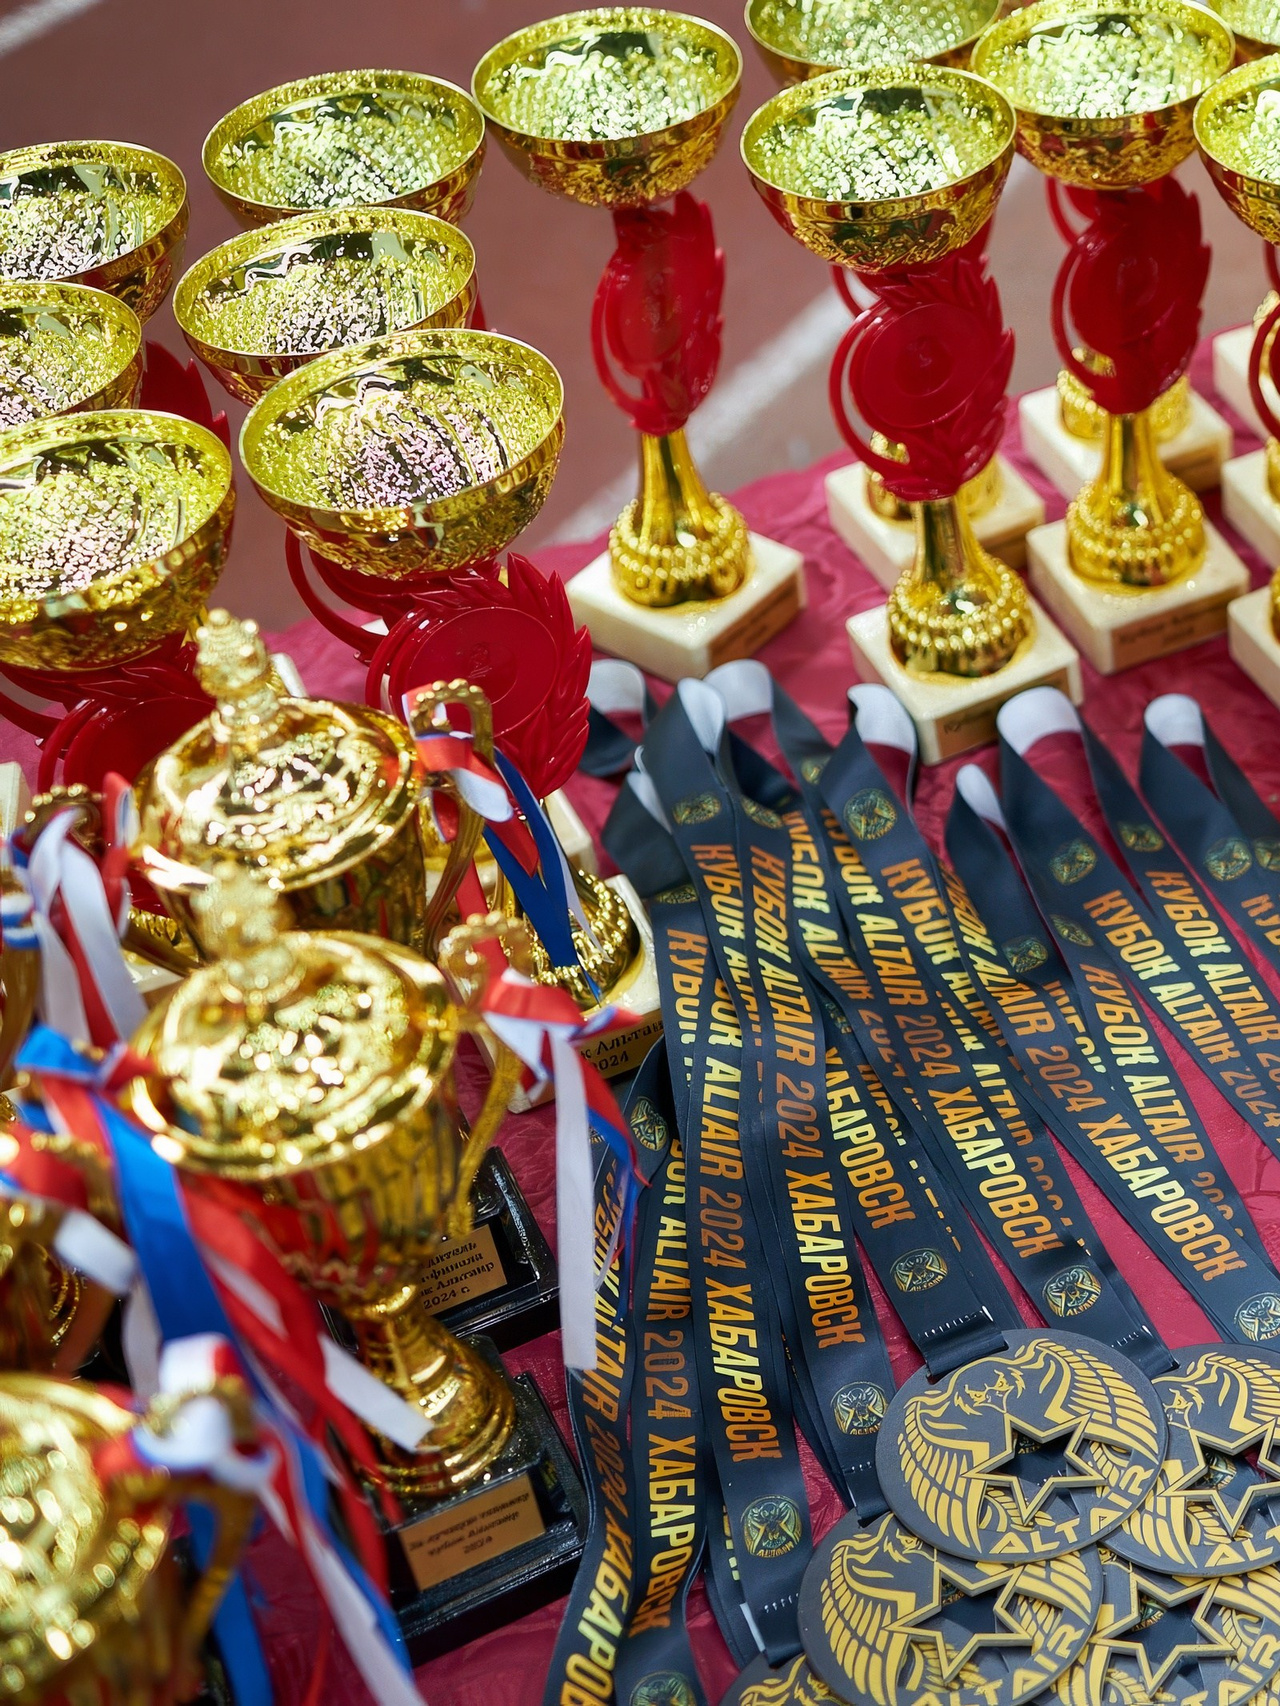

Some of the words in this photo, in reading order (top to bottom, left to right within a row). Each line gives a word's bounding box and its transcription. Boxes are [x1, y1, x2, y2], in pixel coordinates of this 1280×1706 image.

[750, 845, 792, 964] КУБОК
[1083, 889, 1181, 980] КУБОК
[1145, 870, 1230, 957] КУБОК
[594, 1050, 629, 1071] 024
[758, 958, 816, 1067] ALTAIR
[1079, 964, 1160, 1066] КУБОК
[1122, 1075, 1205, 1163] ALTAIR
[776, 1072, 824, 1158] 2024
[856, 913, 929, 1006] ALTAIR
[894, 1014, 961, 1078] 2024
[928, 1086, 1065, 1259] ХАБАРОВСК
[968, 953, 1056, 1036] ALTAIR
[1025, 1045, 1107, 1112] 2024
[1077, 1113, 1247, 1282] ХАБАРОВСК
[700, 1185, 747, 1269] 2024
[785, 1169, 866, 1349] ХАБАРОВСК
[643, 1329, 692, 1420] 2024
[705, 1277, 783, 1463] ХАБАРОВСК
[627, 1433, 697, 1638] ХАБАРОВСК
[989, 1462, 1157, 1555] ALTAIR
